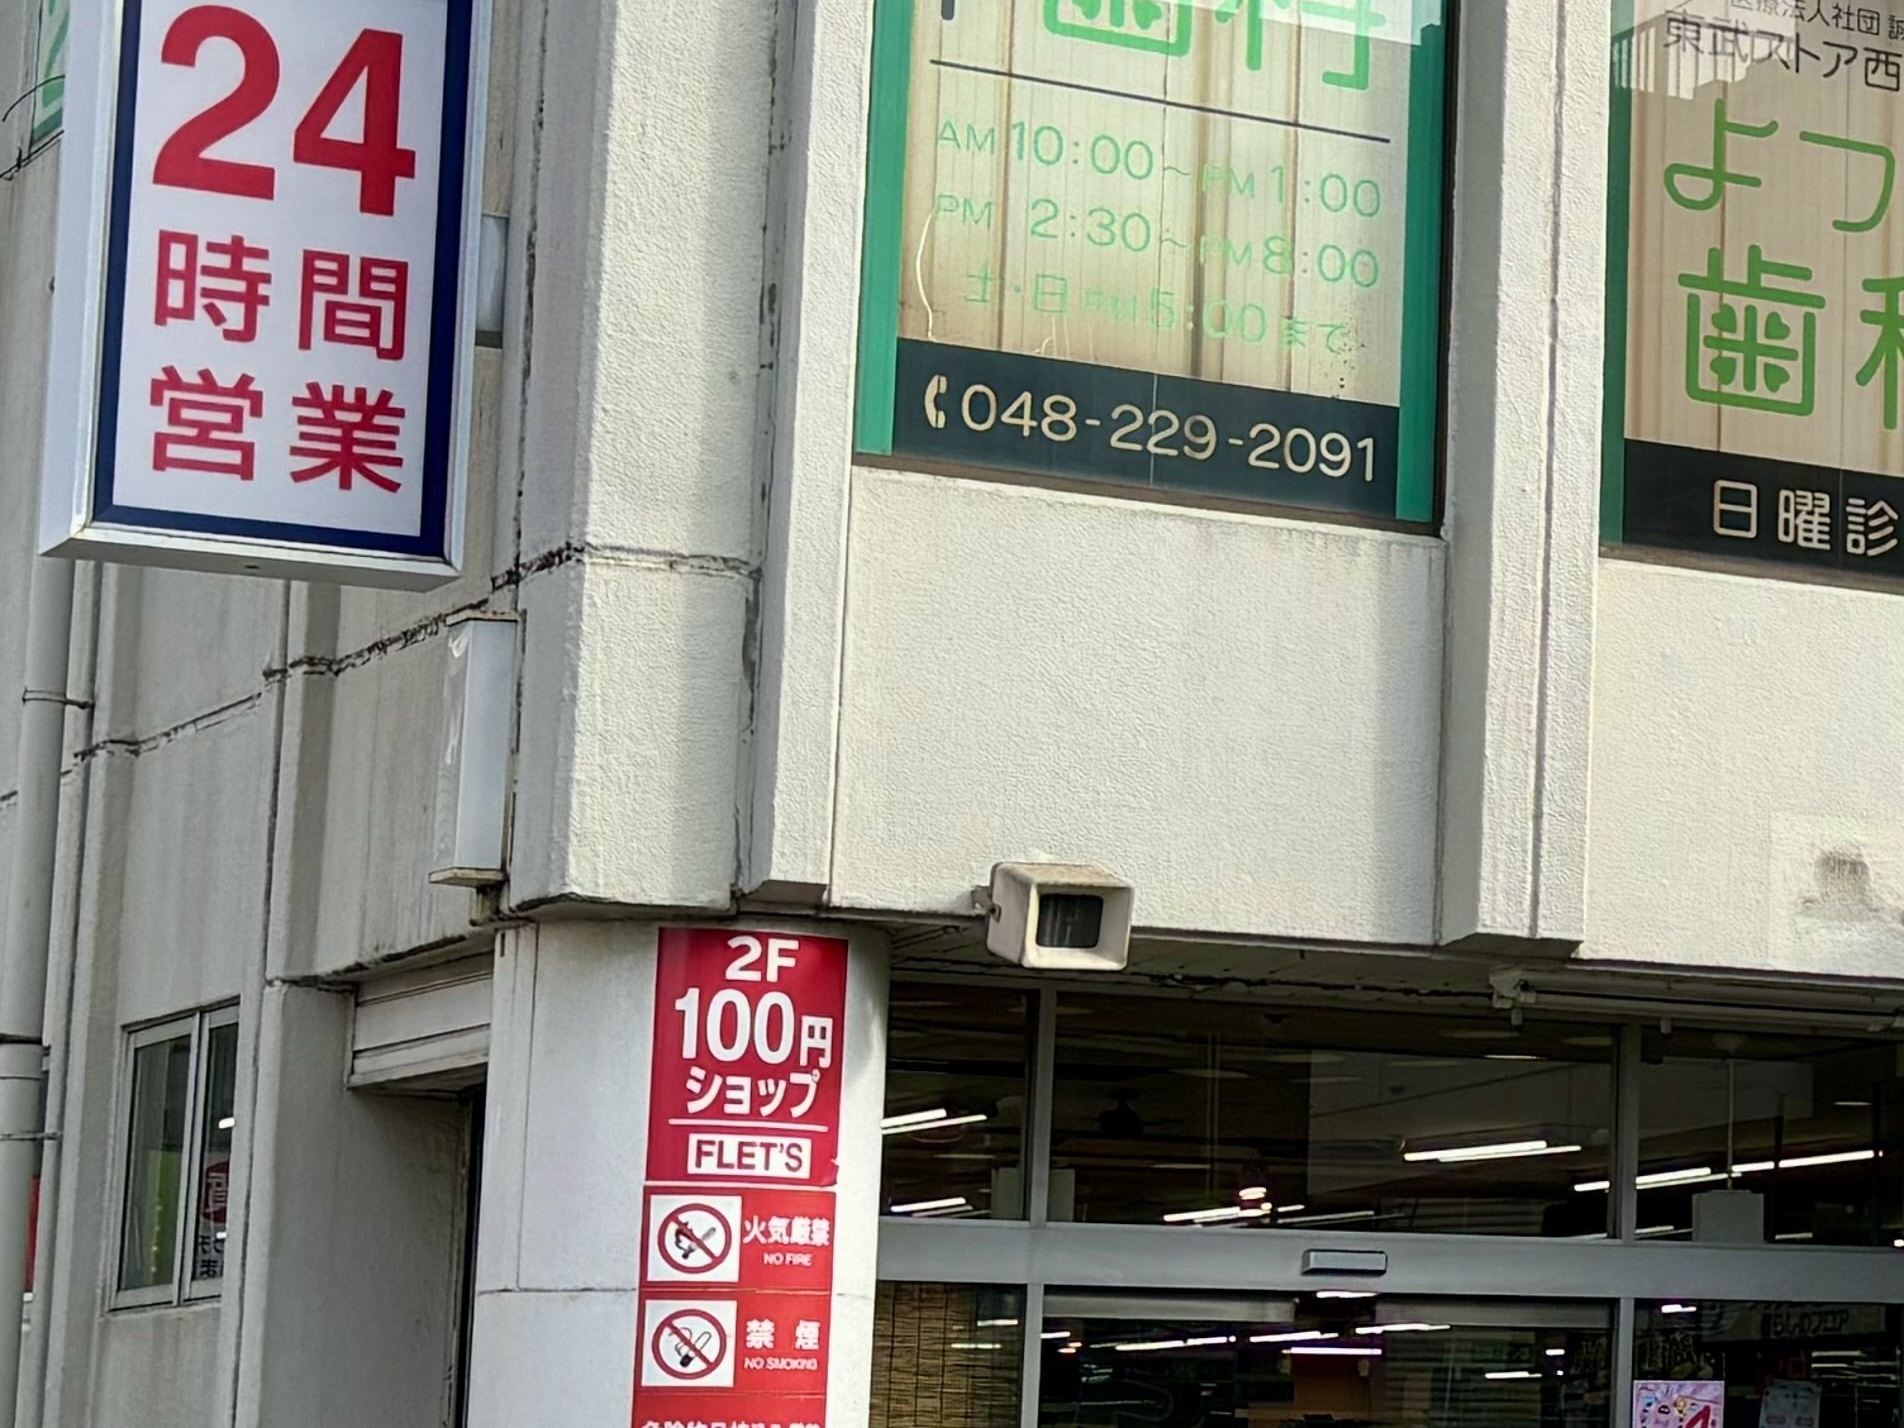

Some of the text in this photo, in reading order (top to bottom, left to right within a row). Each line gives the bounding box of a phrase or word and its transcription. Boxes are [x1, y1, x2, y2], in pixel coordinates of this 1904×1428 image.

[150, 4, 417, 218] 24
[153, 234, 411, 363] 時間
[147, 367, 405, 493] 営業
[961, 383, 1377, 481] 048-229-2091
[725, 936, 799, 983] 2F
[675, 987, 834, 1069] 100円
[686, 1066, 821, 1118] ショップ
[695, 1139, 803, 1173] FLET'S
[743, 1215, 830, 1246] 火気厳禁
[763, 1252, 813, 1267] NO FIRE
[746, 1319, 820, 1350] 禁煙
[744, 1358, 818, 1371] NO SMOKING
